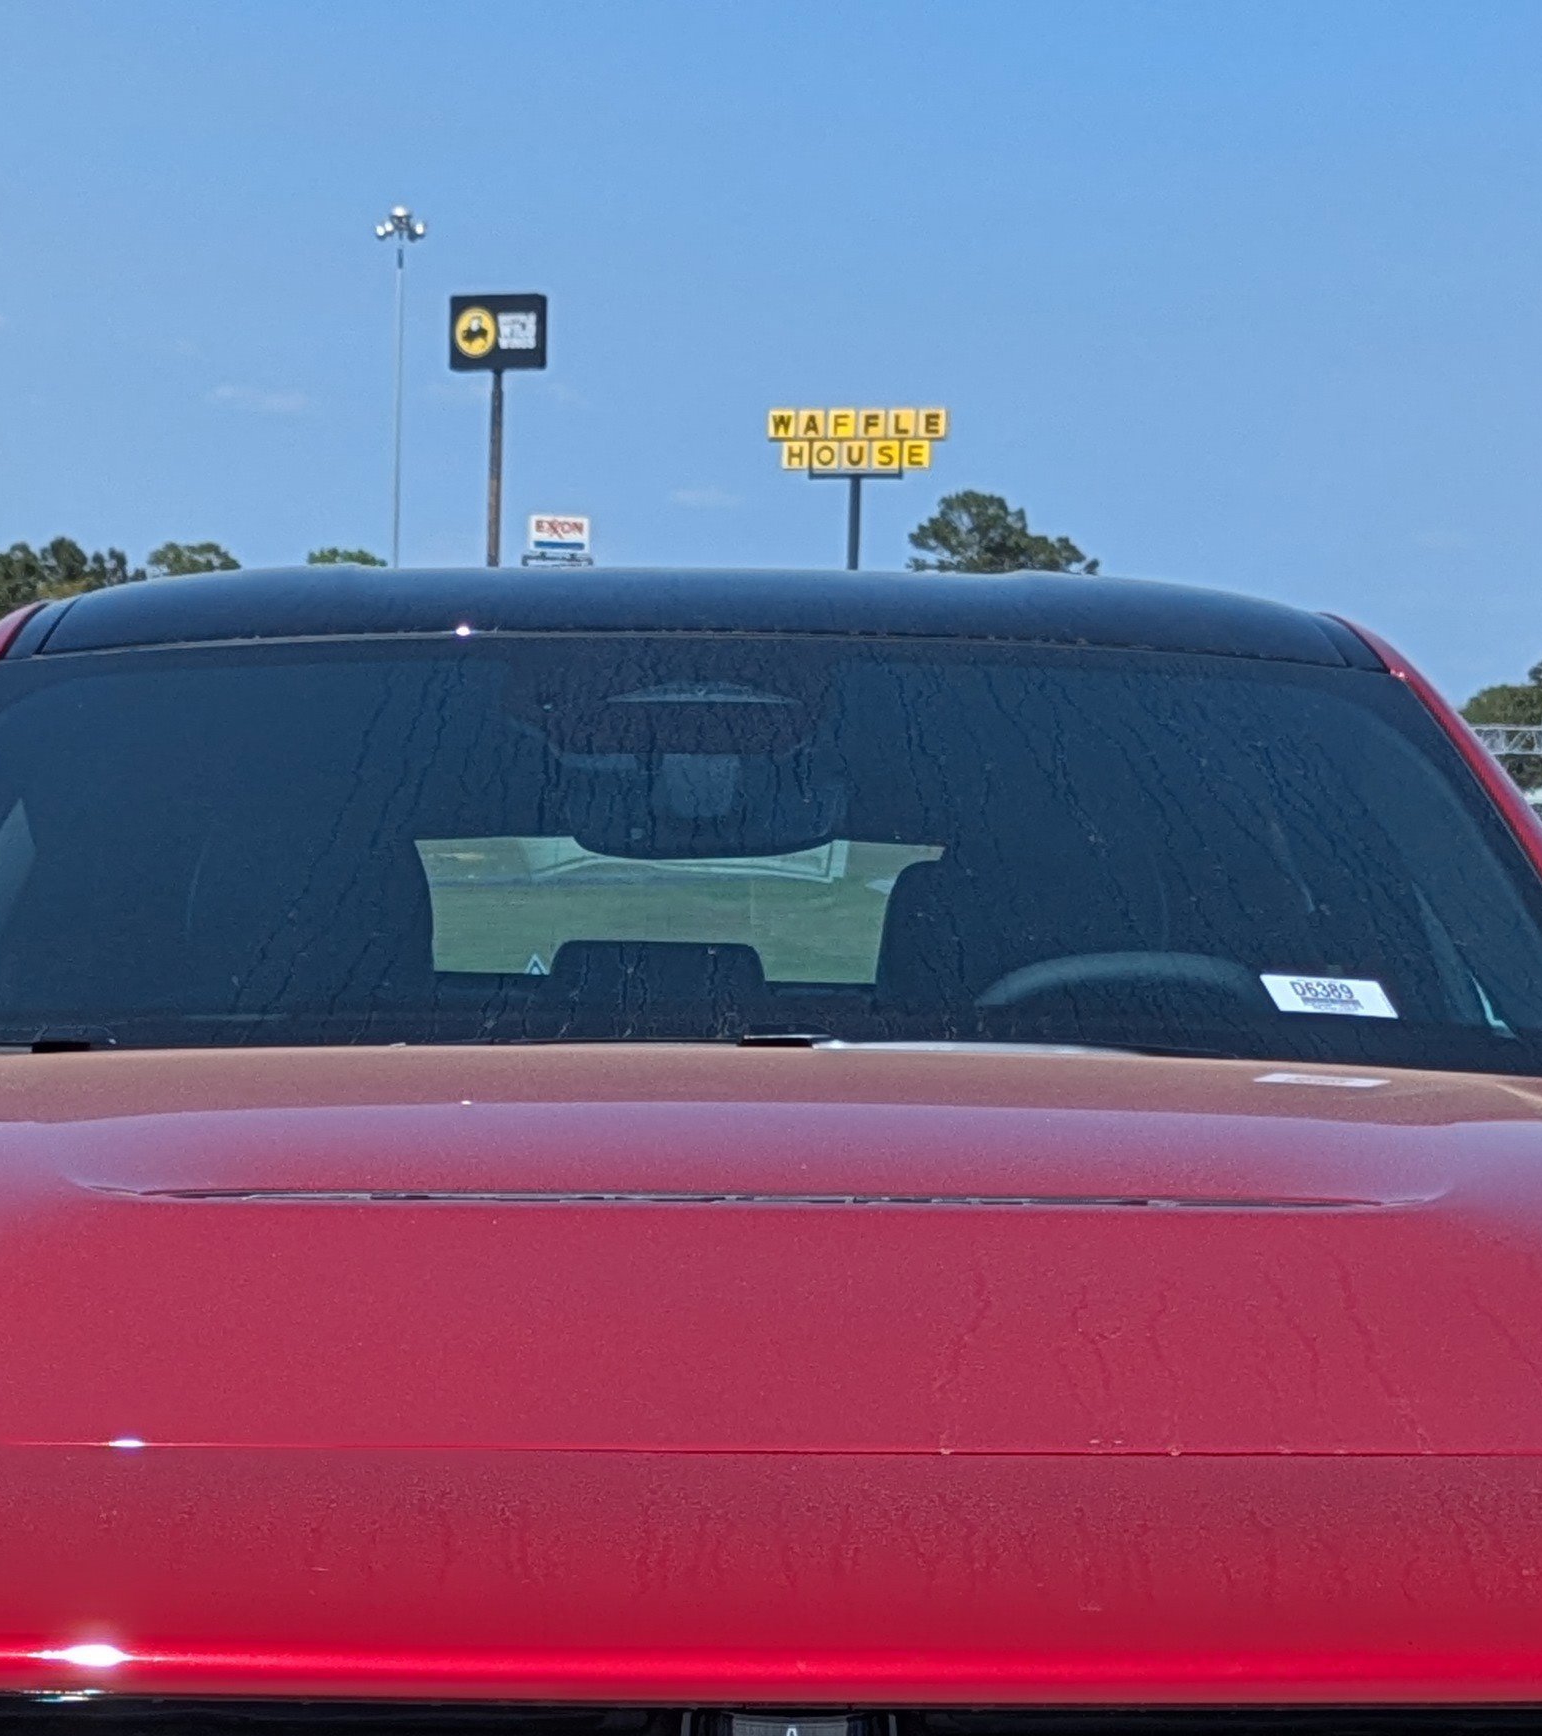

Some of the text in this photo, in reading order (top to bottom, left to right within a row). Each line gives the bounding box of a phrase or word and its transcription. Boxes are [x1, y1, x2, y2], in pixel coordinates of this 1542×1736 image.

[772, 414, 940, 435] WAFFLE
[787, 445, 924, 466] HOUSE
[1289, 981, 1355, 999] D6389
